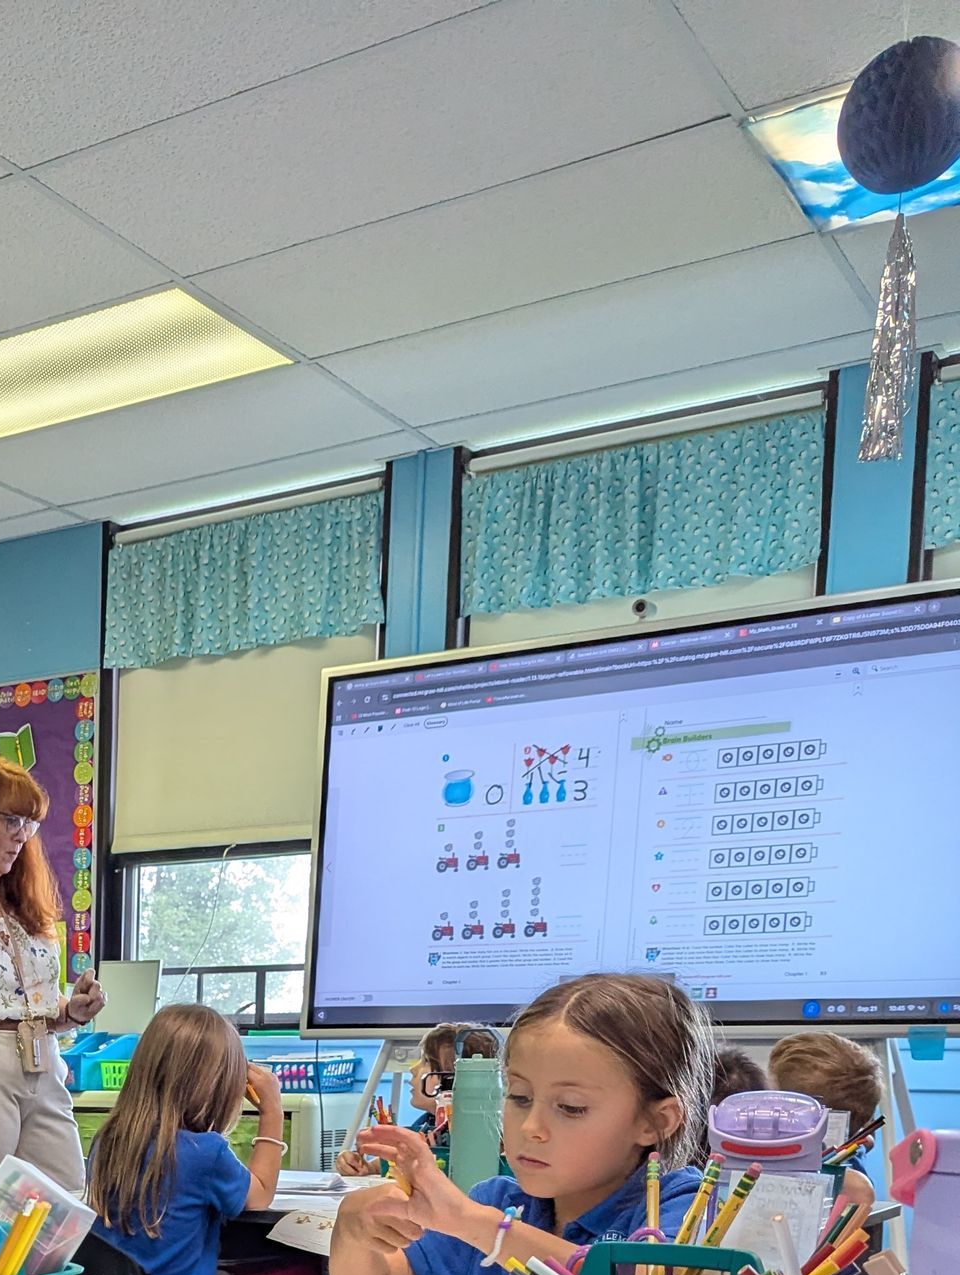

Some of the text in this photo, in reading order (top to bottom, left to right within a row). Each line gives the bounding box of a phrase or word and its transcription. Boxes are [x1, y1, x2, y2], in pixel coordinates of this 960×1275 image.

[662, 733, 712, 745] Brain Builders
[578, 748, 590, 769] 4
[573, 780, 589, 801] 3
